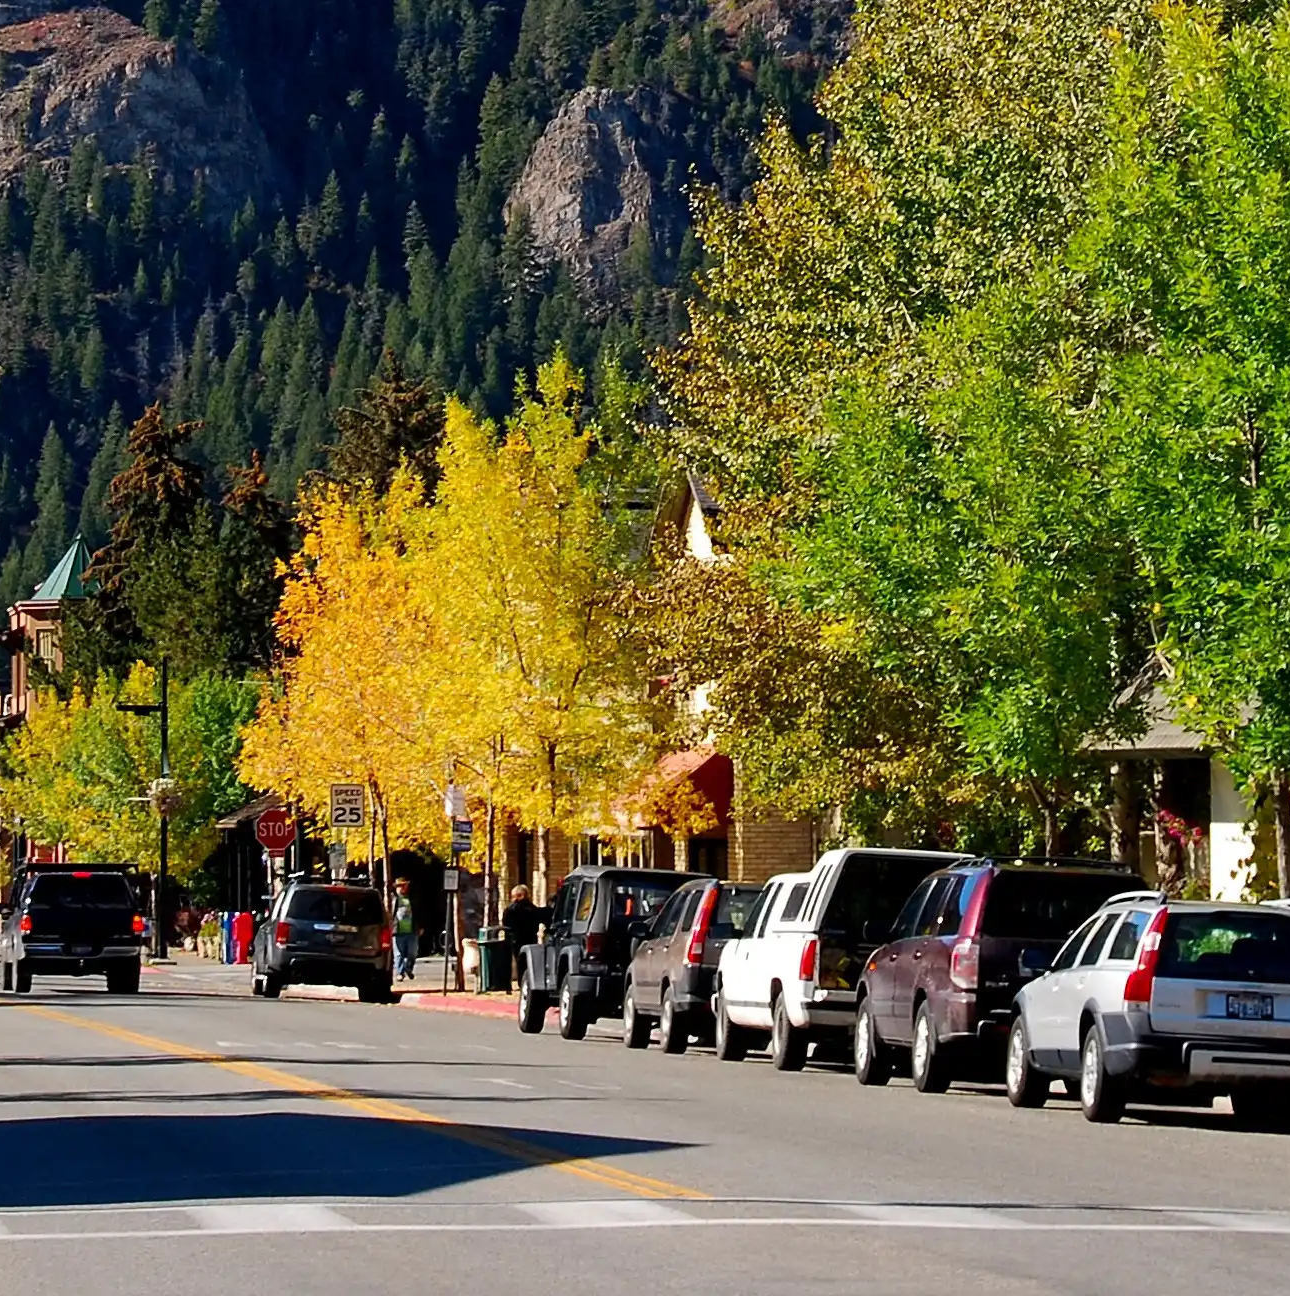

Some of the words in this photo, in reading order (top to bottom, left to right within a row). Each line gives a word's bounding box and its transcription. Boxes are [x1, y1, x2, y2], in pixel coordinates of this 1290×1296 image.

[334, 789, 362, 797] SPEED
[336, 798, 359, 806] LIMIT
[334, 807, 362, 823] 25
[259, 822, 293, 837] STOP
